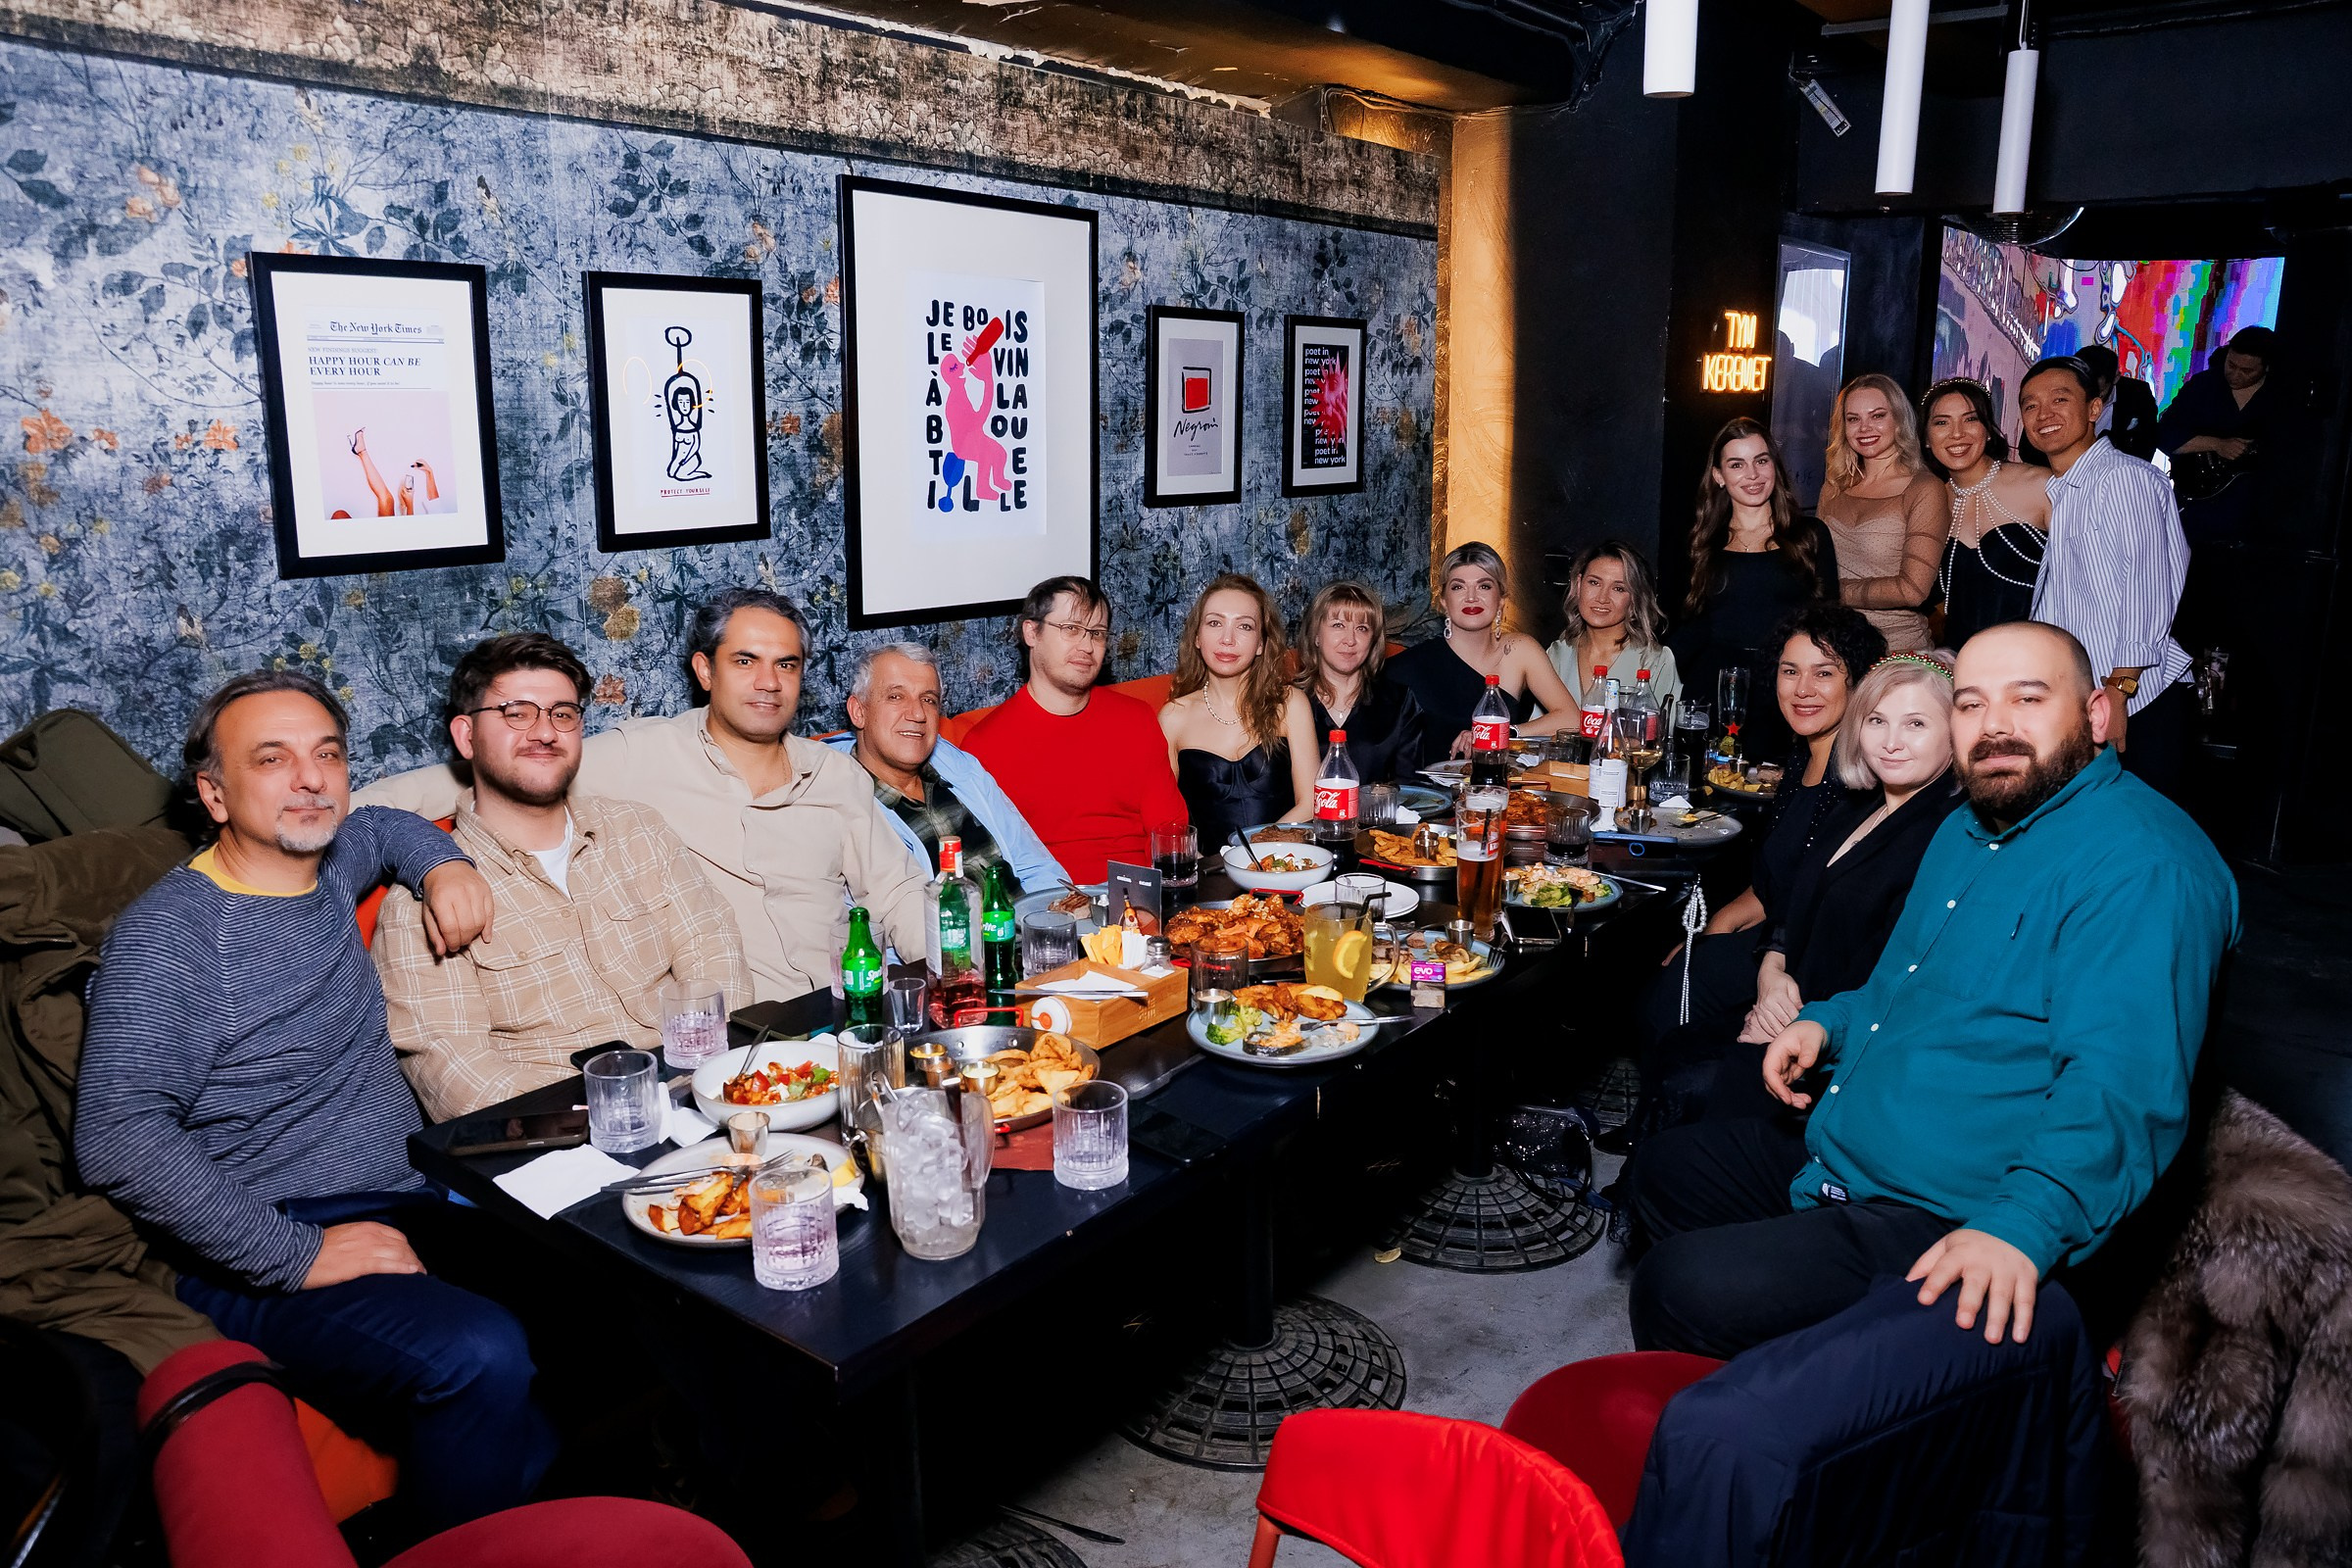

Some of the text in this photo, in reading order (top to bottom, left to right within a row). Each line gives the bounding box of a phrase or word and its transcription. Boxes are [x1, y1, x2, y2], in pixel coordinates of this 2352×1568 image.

[926, 300, 955, 327] JE
[330, 321, 422, 335] The New York Times
[927, 332, 1029, 378] LE VIN
[1305, 347, 1320, 357] poet
[309, 356, 421, 367] HAPPY HOUR CAN BE
[310, 367, 381, 376] EVERY HOUR
[1305, 368, 1320, 377] poet
[1702, 354, 1772, 391] KEREMET
[926, 370, 1028, 410] À LA
[1173, 416, 1219, 441] Negroni
[1315, 447, 1330, 458] poet
[1331, 455, 1346, 466] york
[1584, 714, 1603, 728] Coca
[1315, 790, 1341, 813] Cola
[1414, 966, 1434, 975] evo
